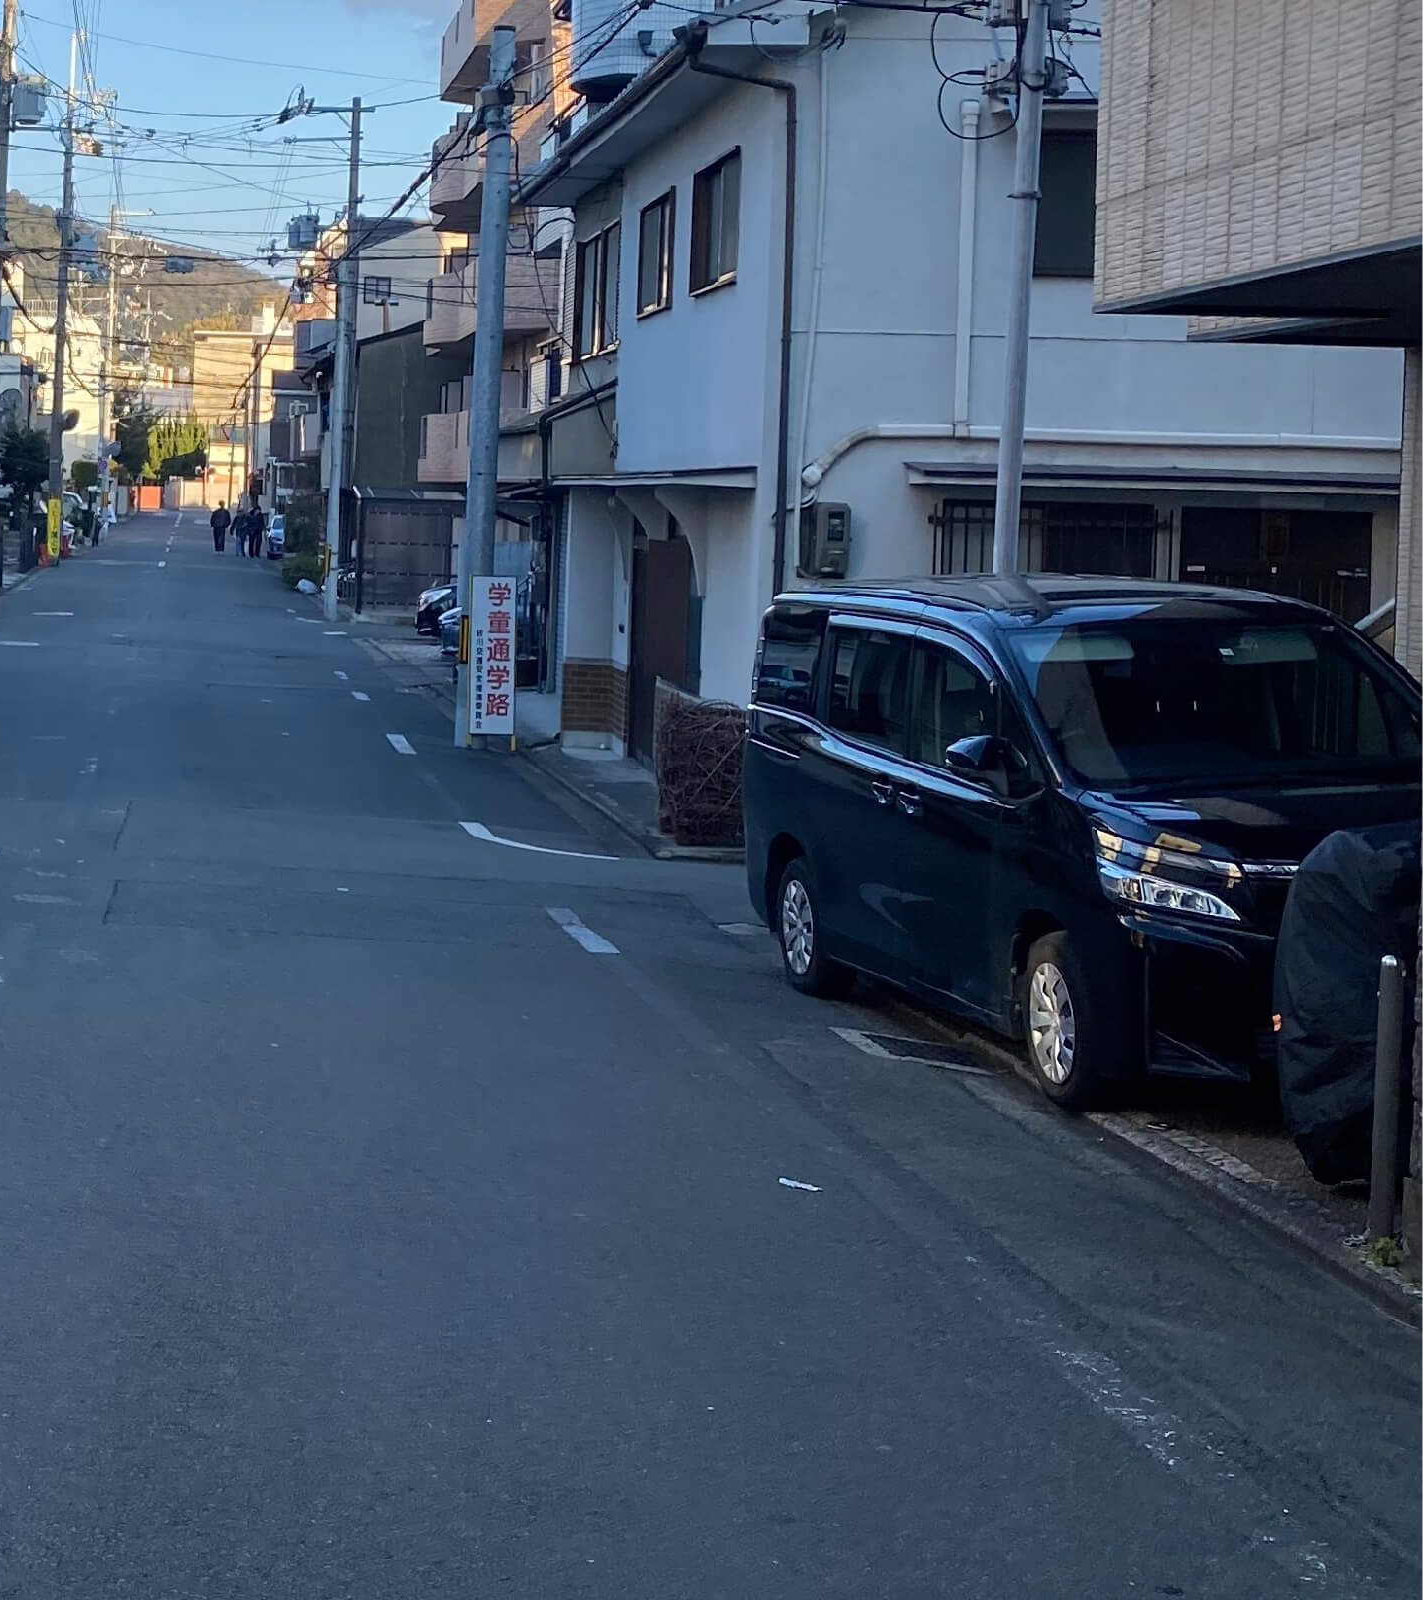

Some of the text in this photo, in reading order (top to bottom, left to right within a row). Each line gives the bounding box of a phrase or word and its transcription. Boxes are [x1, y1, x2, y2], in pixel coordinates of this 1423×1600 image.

[486, 583, 511, 716] 学童通学路
